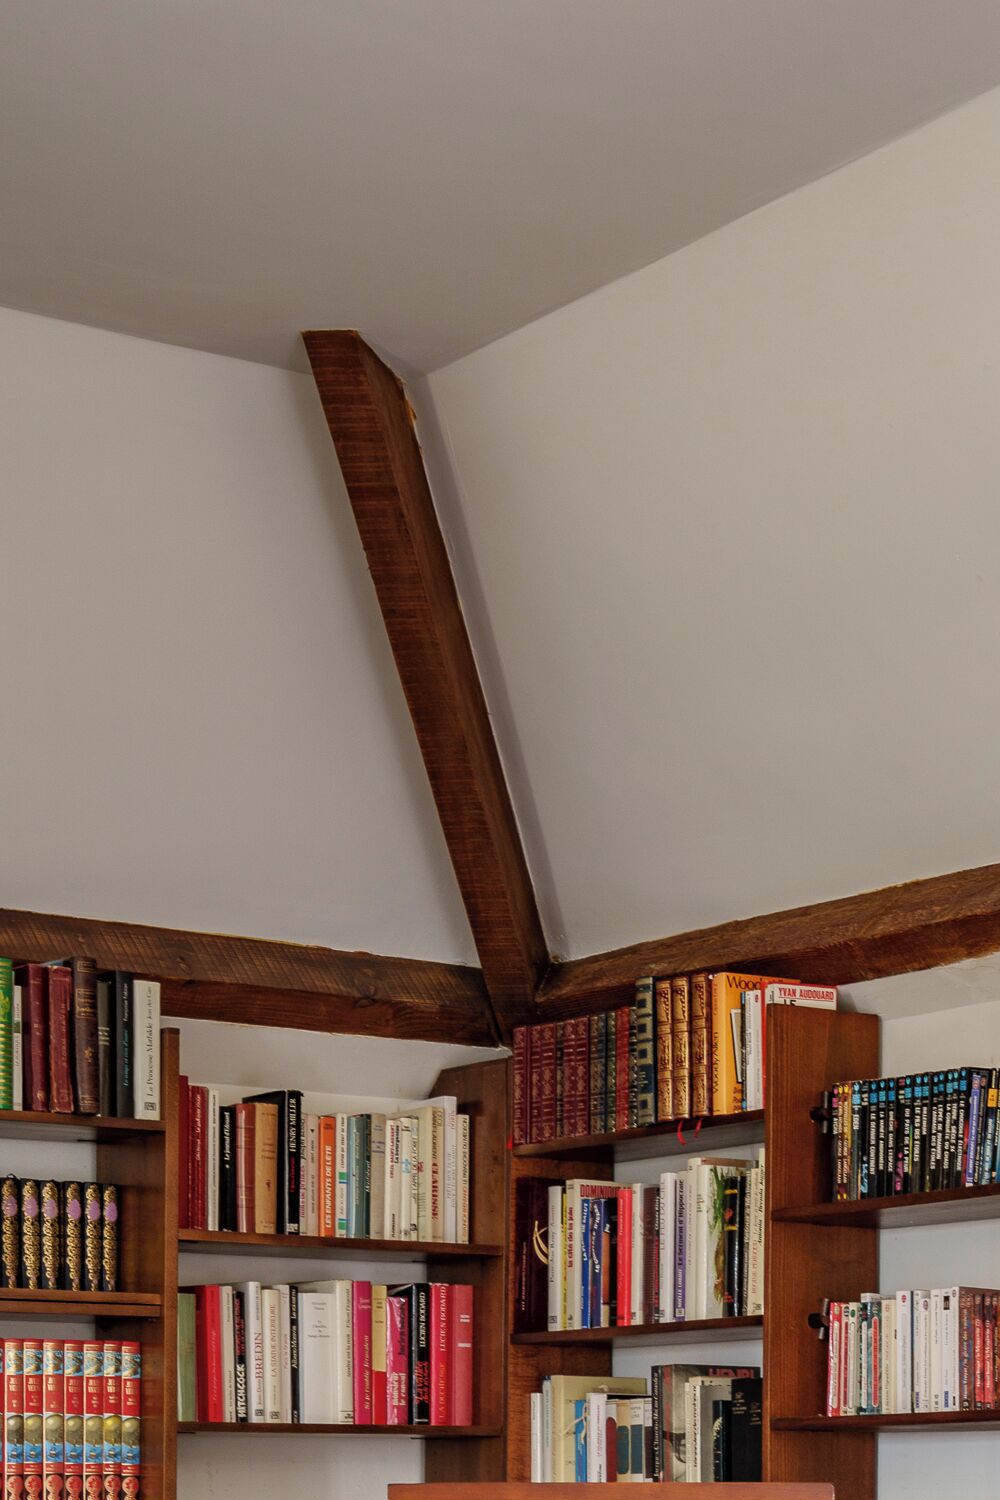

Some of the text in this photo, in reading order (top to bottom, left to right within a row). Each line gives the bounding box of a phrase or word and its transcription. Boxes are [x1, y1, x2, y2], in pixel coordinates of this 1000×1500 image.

[778, 987, 834, 1001] YVAN AUDOUARD
[325, 1166, 332, 1176] DE
[438, 1322, 446, 1351] LUCIEN
[254, 1332, 263, 1379] BREDIN
[236, 1364, 246, 1417] HITCHCOCK
